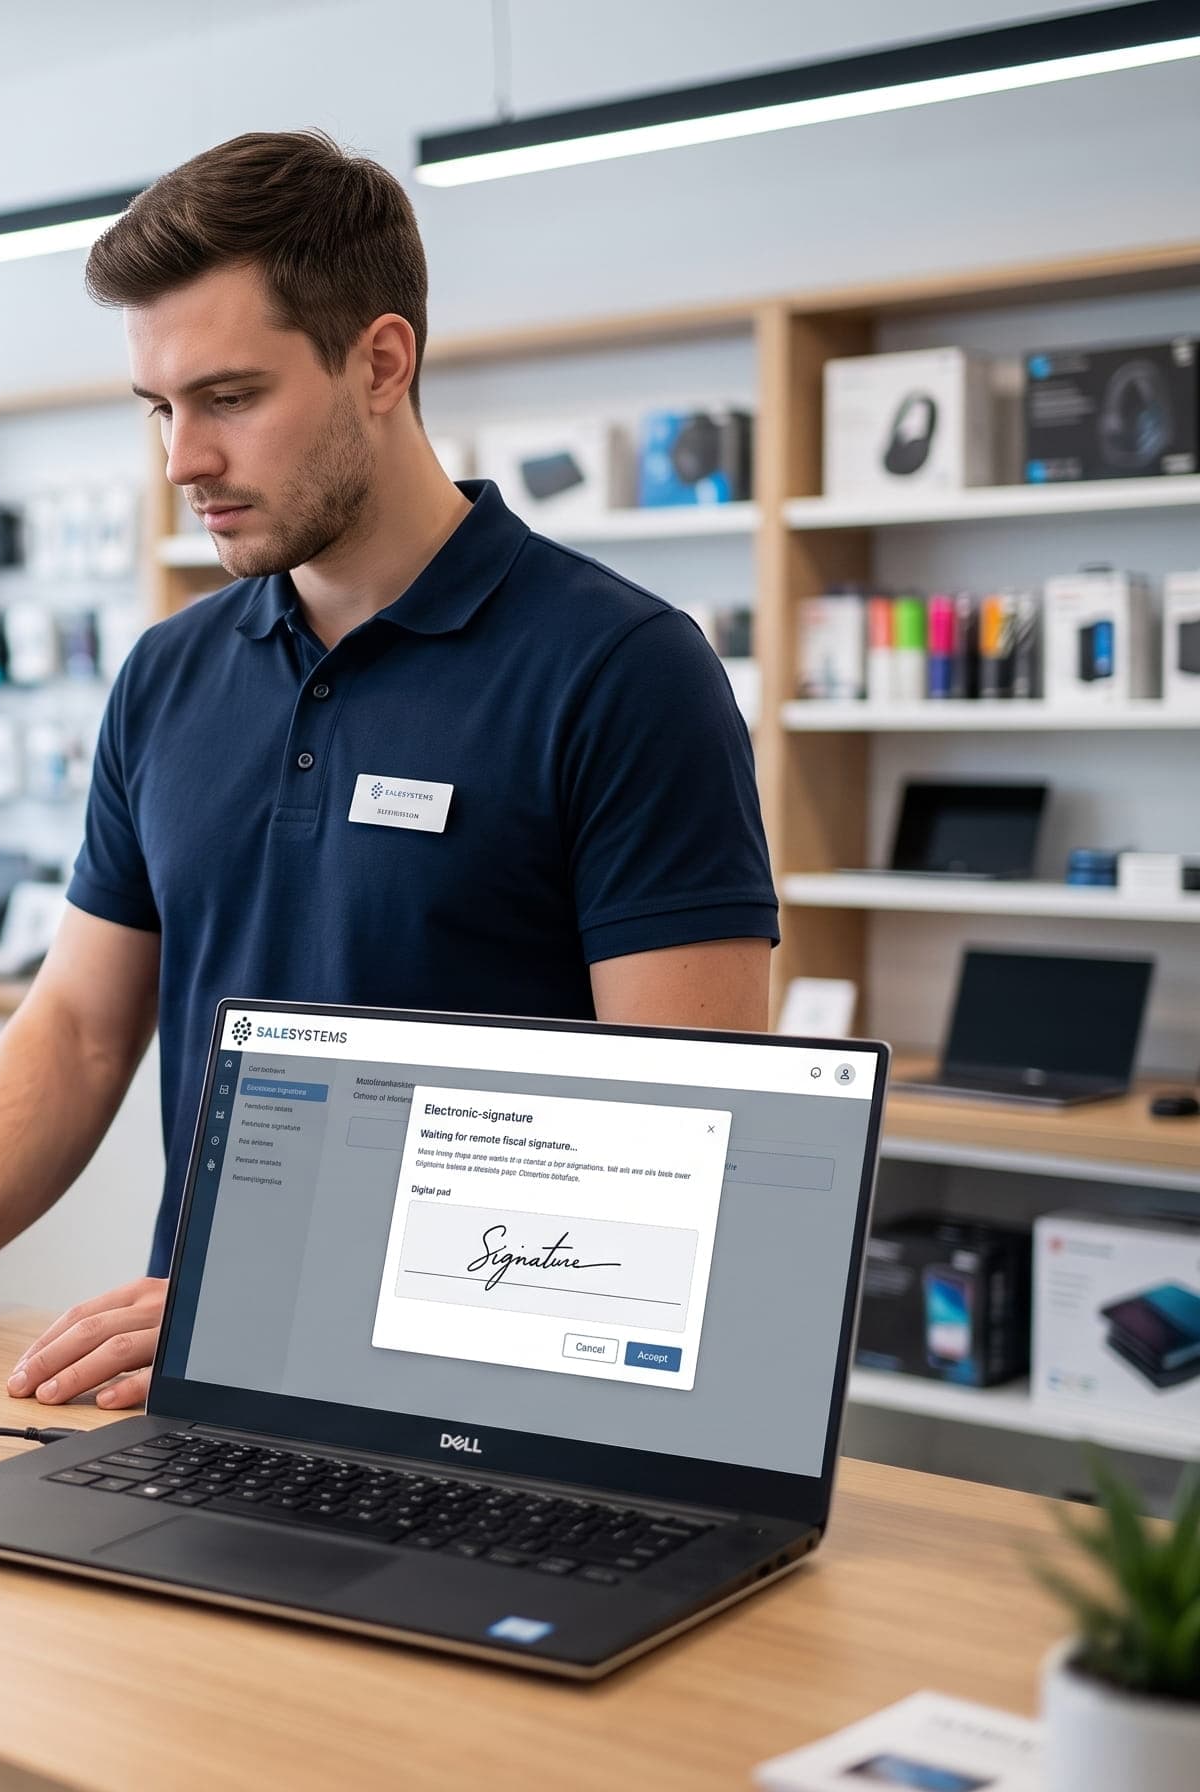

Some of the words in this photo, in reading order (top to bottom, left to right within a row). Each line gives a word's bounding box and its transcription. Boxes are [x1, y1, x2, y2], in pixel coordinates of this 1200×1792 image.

[256, 1026, 348, 1044] SALESYSTEMS
[424, 1103, 533, 1123] Electronic-signature
[420, 1129, 453, 1142] Waiting
[455, 1131, 468, 1141] for
[469, 1135, 501, 1145] remote
[503, 1135, 527, 1147] fiscal
[528, 1139, 578, 1151] signature...
[411, 1185, 435, 1195] Digital
[436, 1187, 451, 1196] pad
[467, 1225, 621, 1290] Signature
[575, 1342, 606, 1354] Cancel
[440, 1433, 482, 1454] DELL
